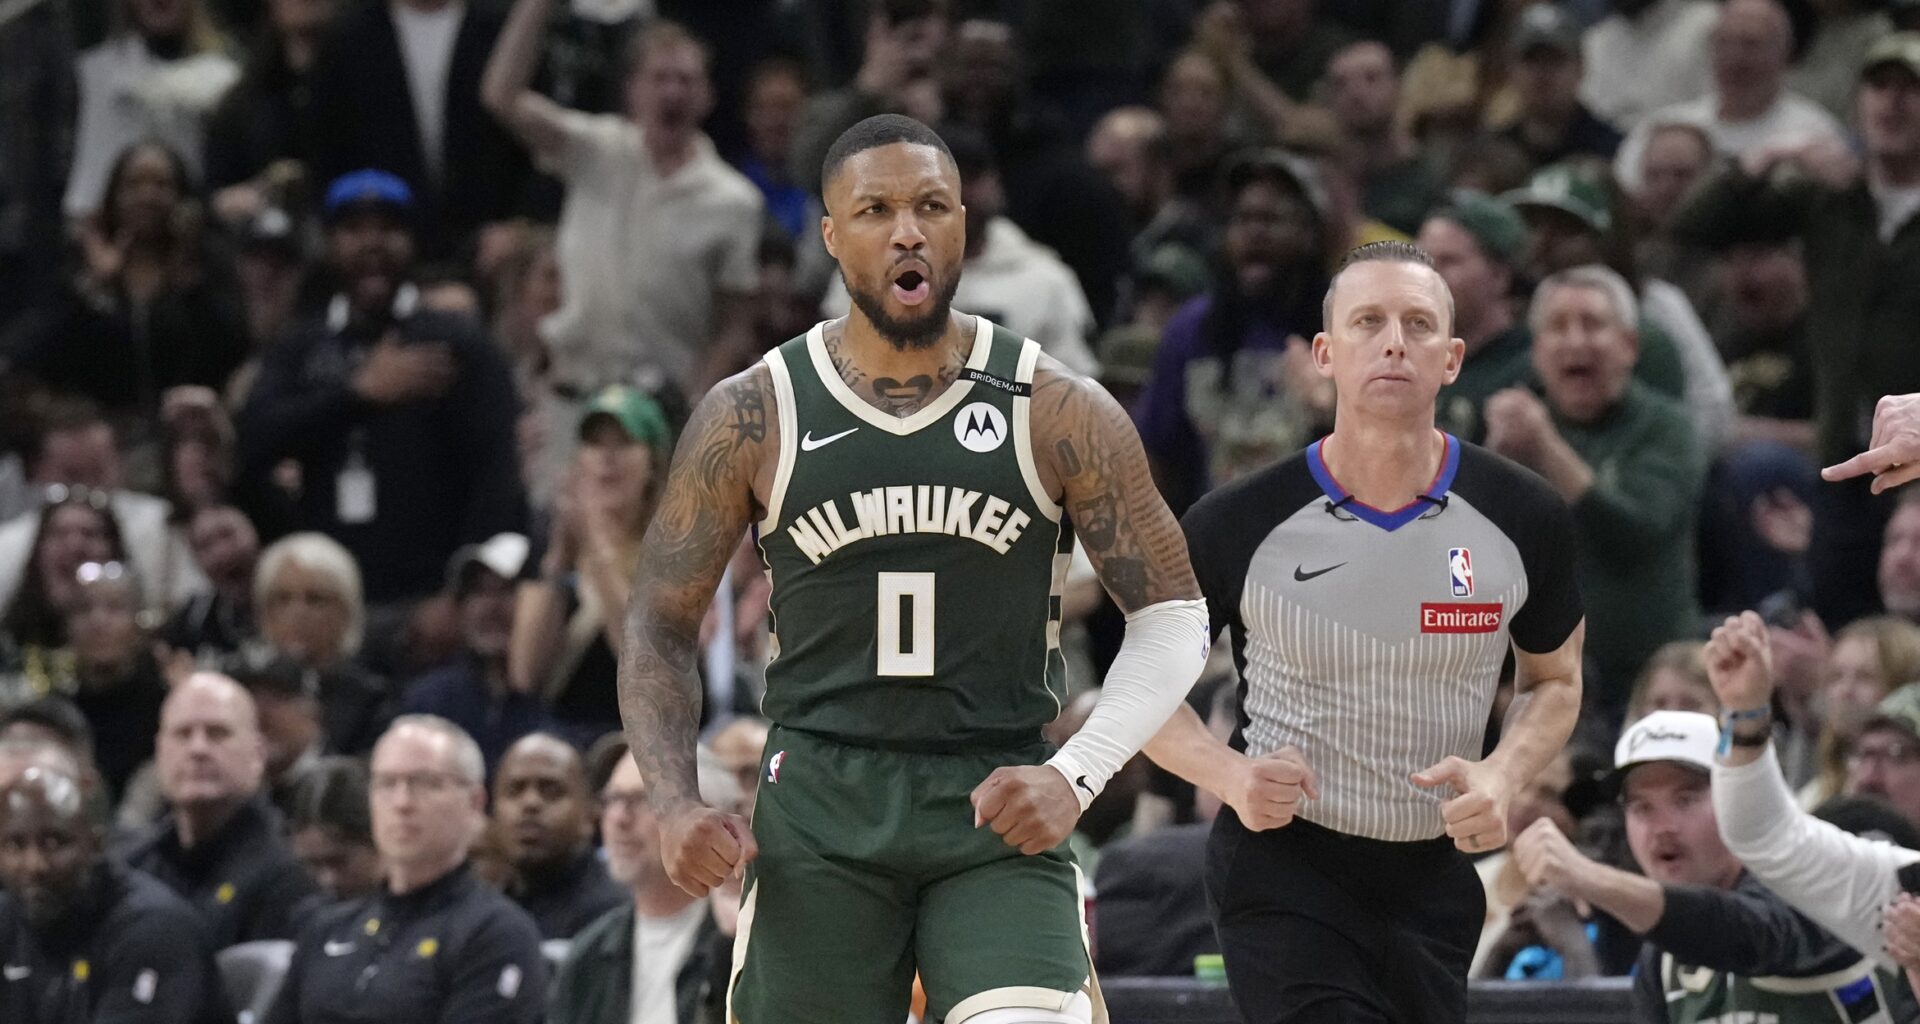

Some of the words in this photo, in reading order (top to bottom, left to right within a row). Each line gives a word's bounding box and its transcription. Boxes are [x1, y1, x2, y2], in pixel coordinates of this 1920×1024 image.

[969, 371, 1023, 392] BRIDGEMAN
[787, 485, 1031, 565] MILWAUKEE
[877, 571, 935, 676] 0
[1423, 609, 1500, 627] Emirates
